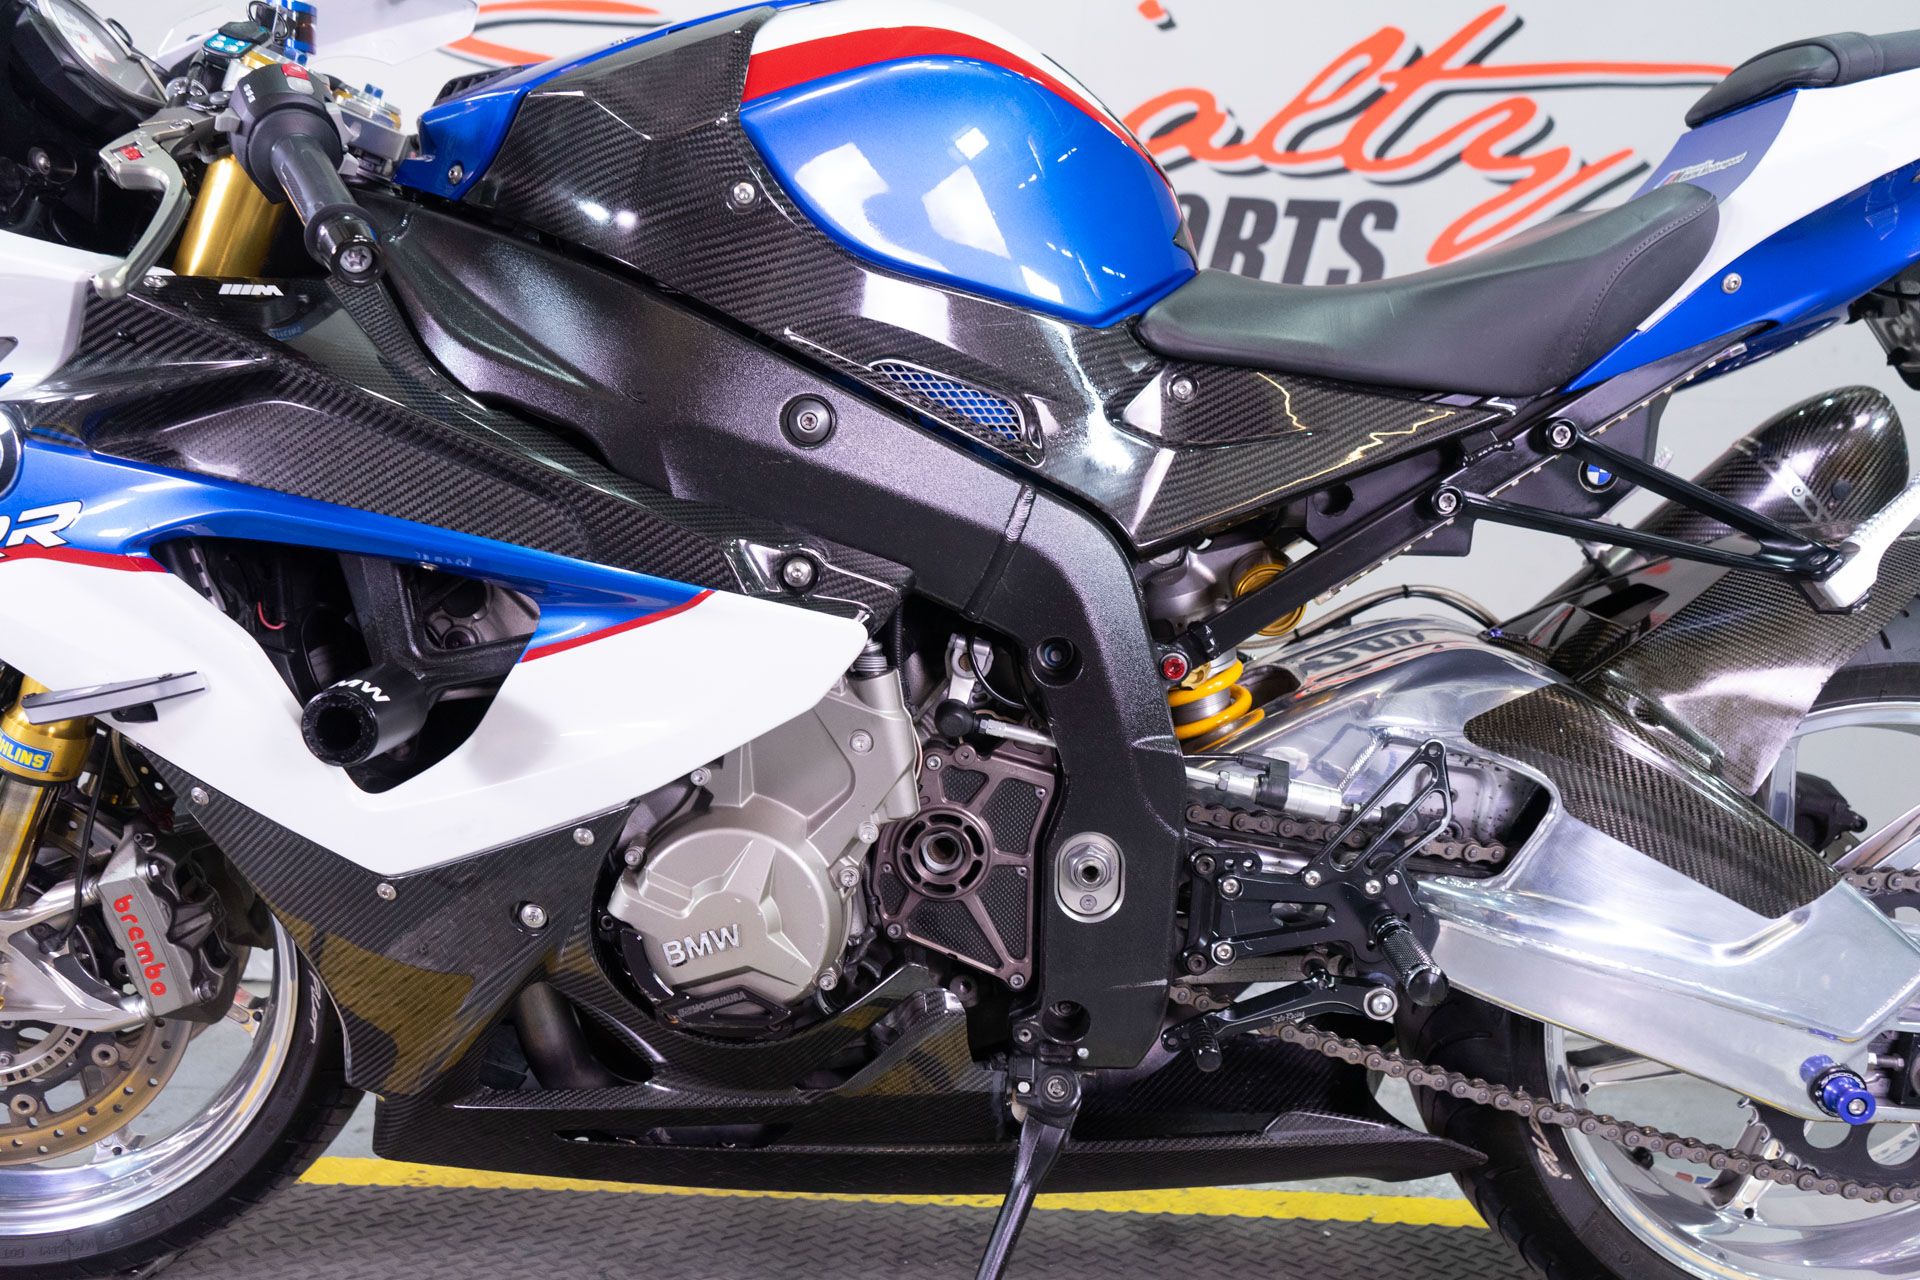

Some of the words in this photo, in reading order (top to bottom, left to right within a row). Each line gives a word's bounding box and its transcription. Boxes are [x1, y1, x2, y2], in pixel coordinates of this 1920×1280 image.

[0, 500, 83, 558] R
[328, 679, 391, 702] MW
[114, 895, 167, 996] brembo
[662, 923, 740, 968] BMW
